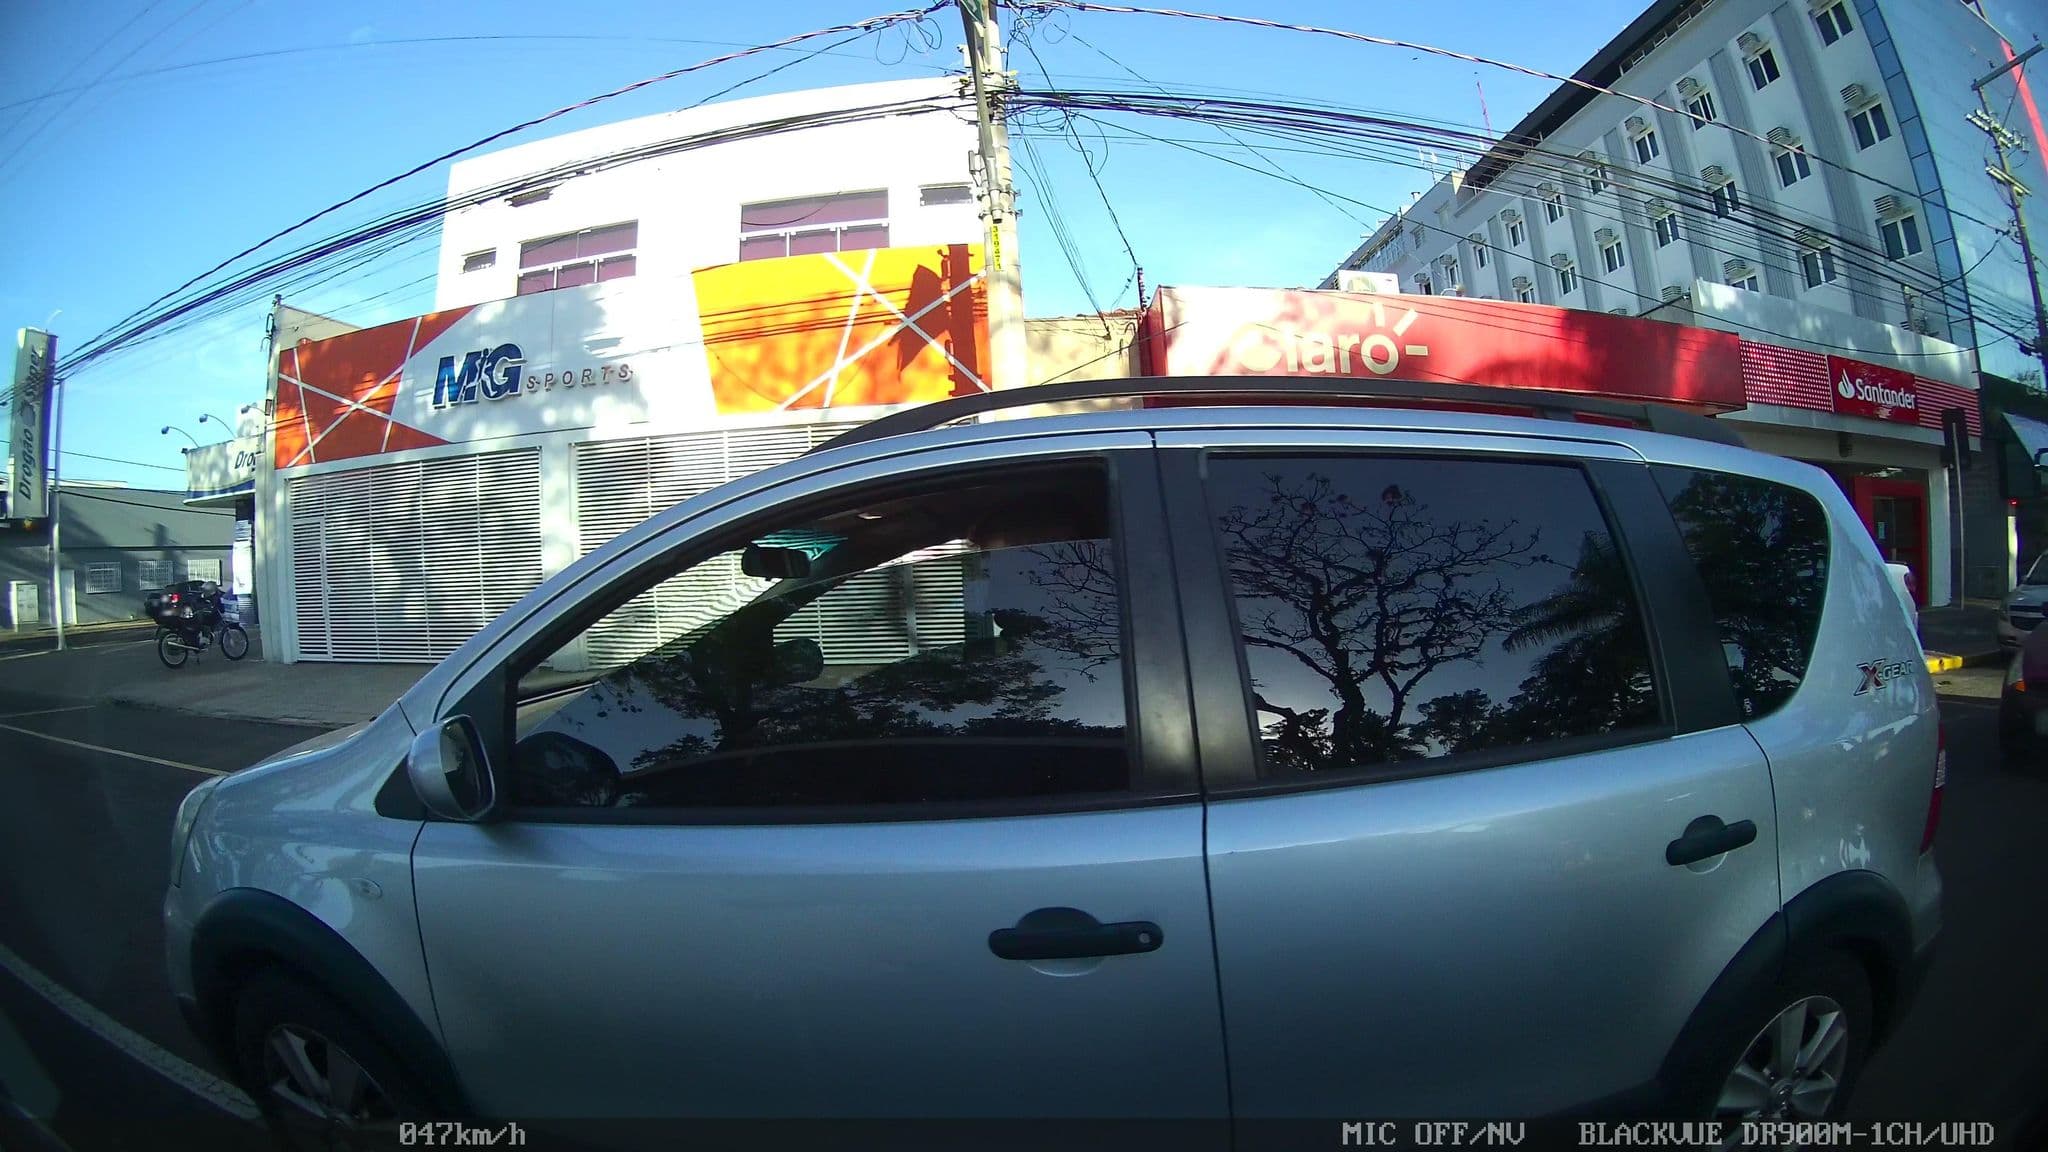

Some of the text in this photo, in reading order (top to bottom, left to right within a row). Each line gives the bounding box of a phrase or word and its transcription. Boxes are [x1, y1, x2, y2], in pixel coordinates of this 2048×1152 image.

[1233, 321, 1401, 376] Claro
[526, 363, 635, 394] SPORTS
[1855, 378, 1917, 410] Santander
